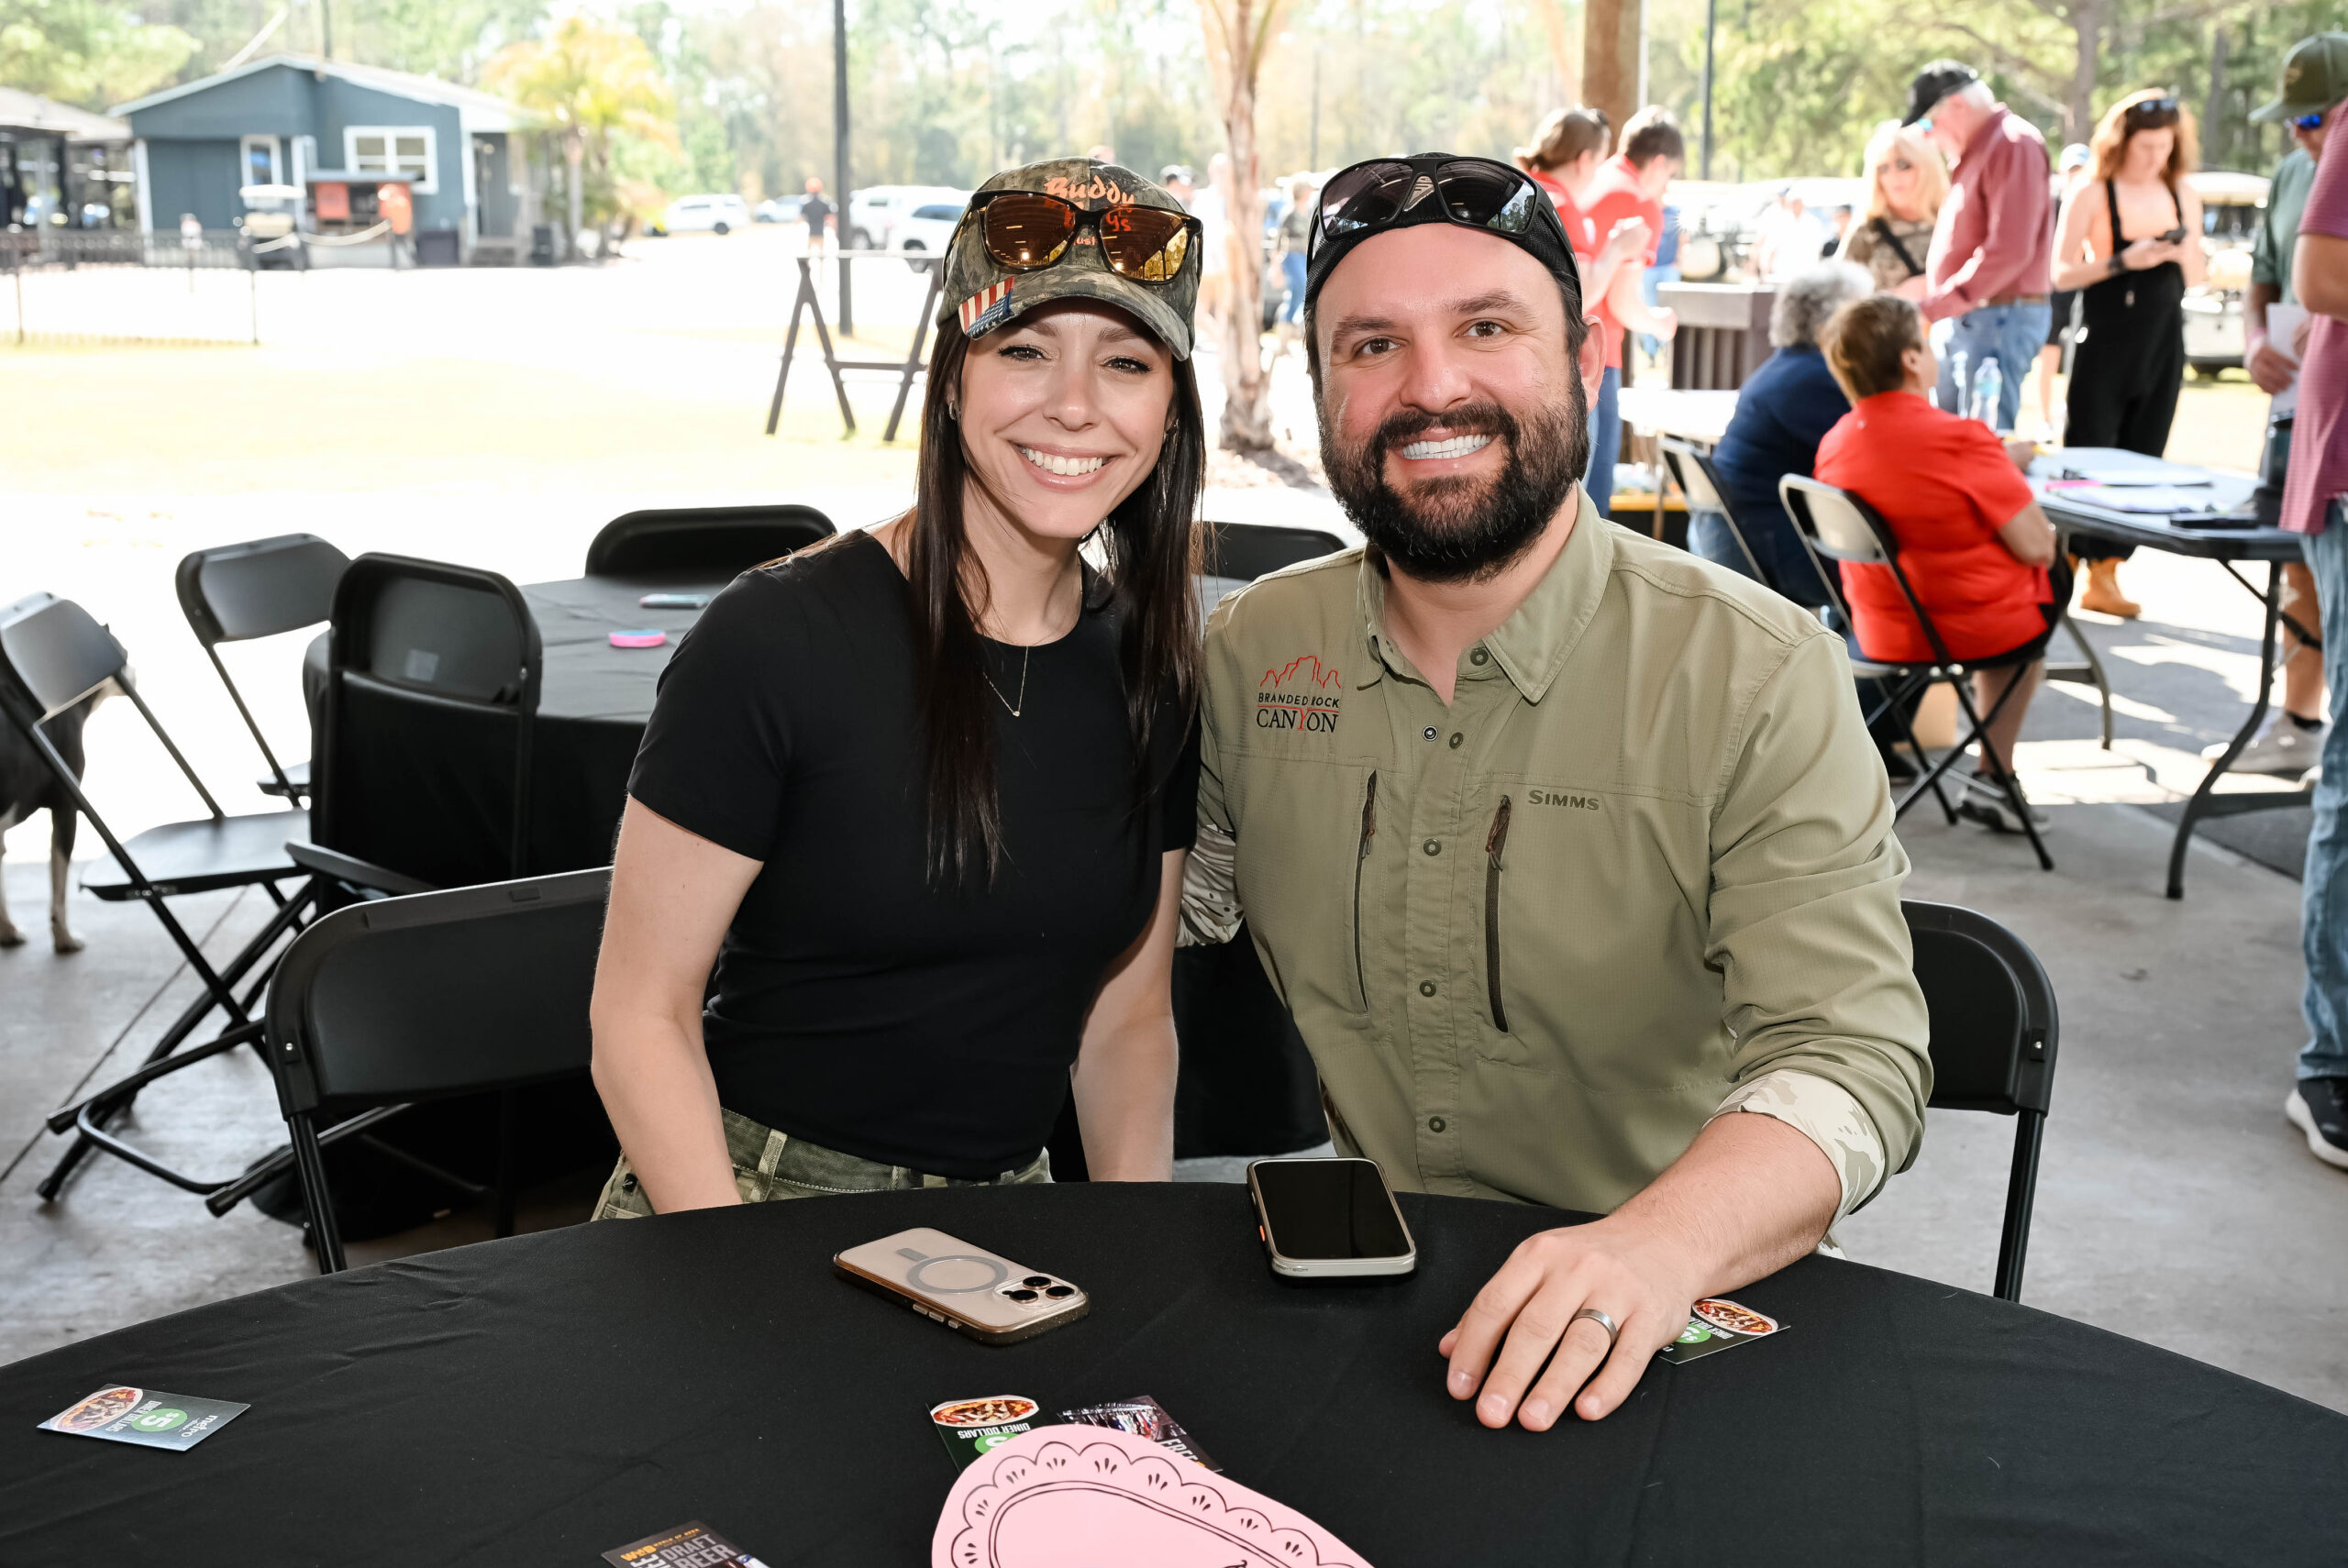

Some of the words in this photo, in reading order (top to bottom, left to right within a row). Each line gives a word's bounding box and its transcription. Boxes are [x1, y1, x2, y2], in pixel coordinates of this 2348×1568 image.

[1044, 175, 1135, 206] Buddy
[1257, 691, 1309, 706] BRANDED
[1311, 695, 1340, 709] ROCK
[1256, 707, 1339, 734] CANYON
[1527, 790, 1600, 811] SIMMS
[181, 1415, 219, 1439] metro
[957, 1426, 1001, 1440] DOLLARS
[1001, 1422, 1031, 1433] DINER
[659, 1533, 716, 1559] DRAFT
[673, 1544, 737, 1568] BEER
